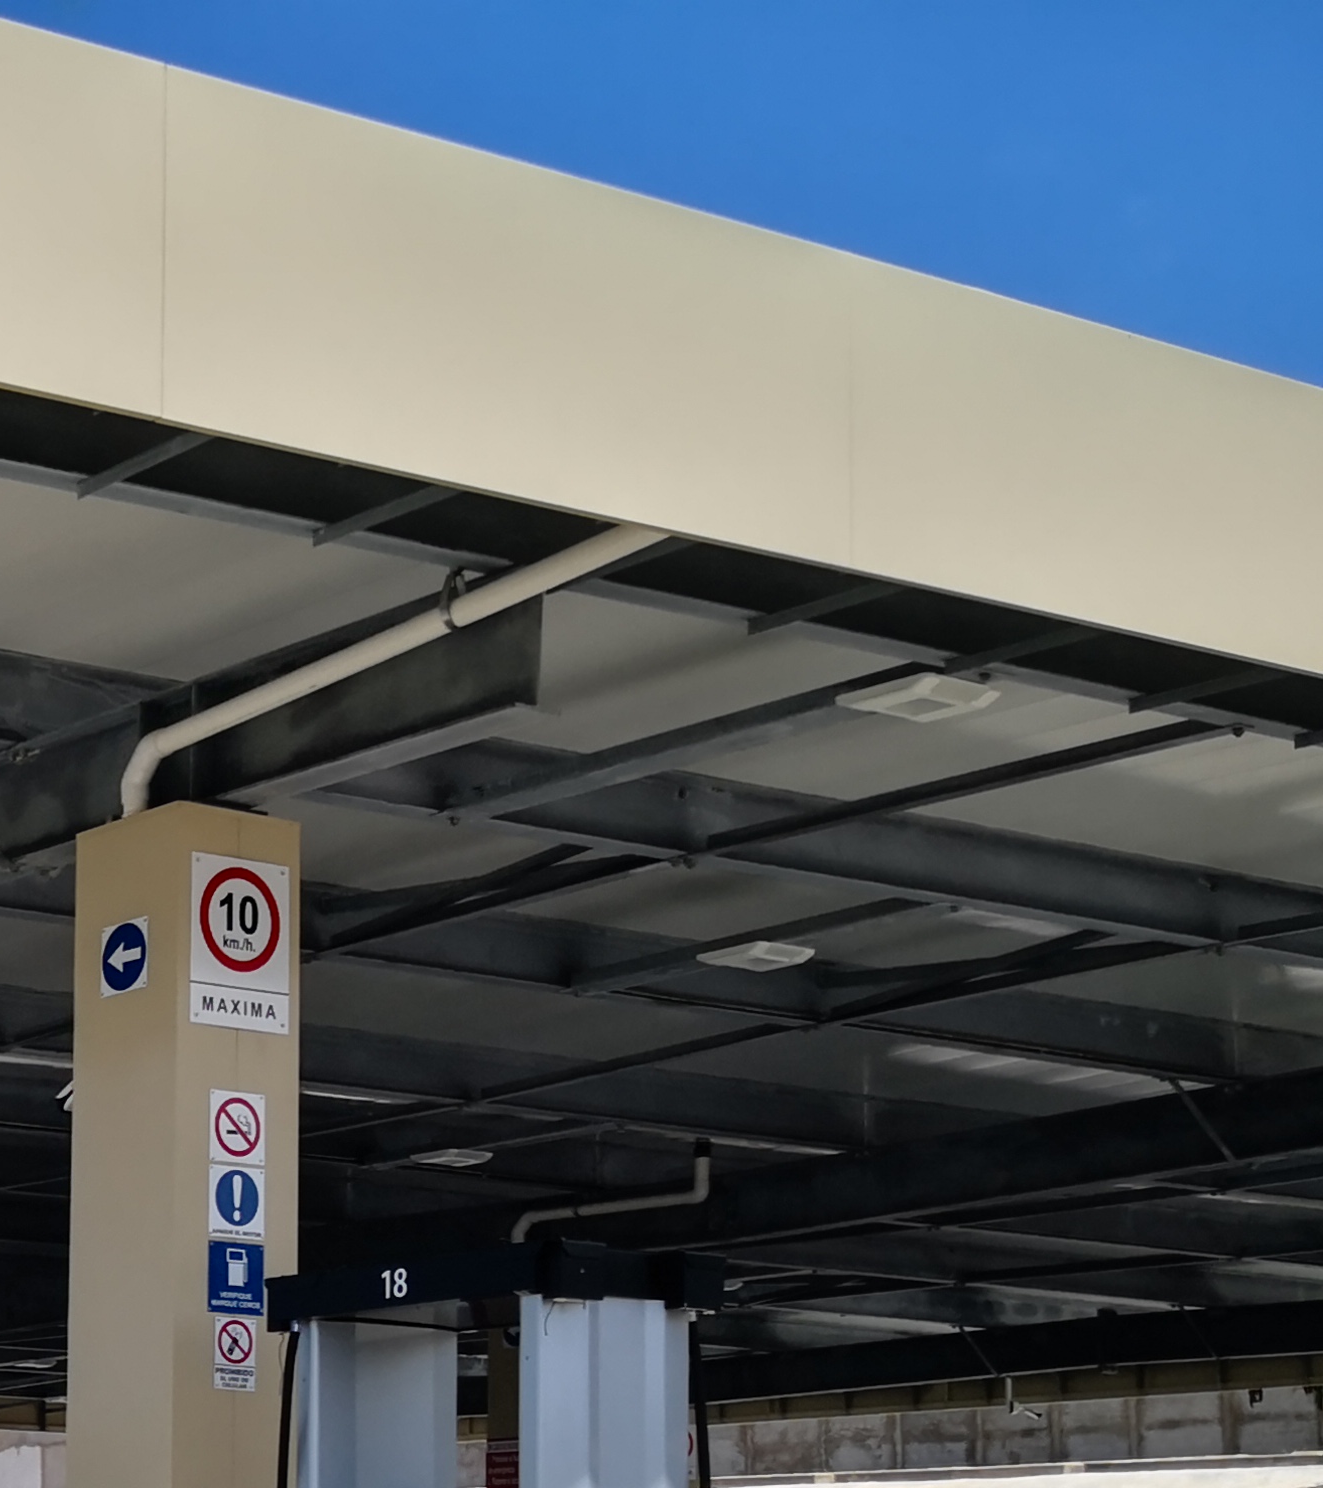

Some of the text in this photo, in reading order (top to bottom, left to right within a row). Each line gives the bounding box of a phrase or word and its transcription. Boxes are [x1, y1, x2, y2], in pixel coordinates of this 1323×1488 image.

[219, 892, 259, 935] 10
[202, 995, 277, 1020] MAXIMA
[381, 1268, 408, 1299] 18
